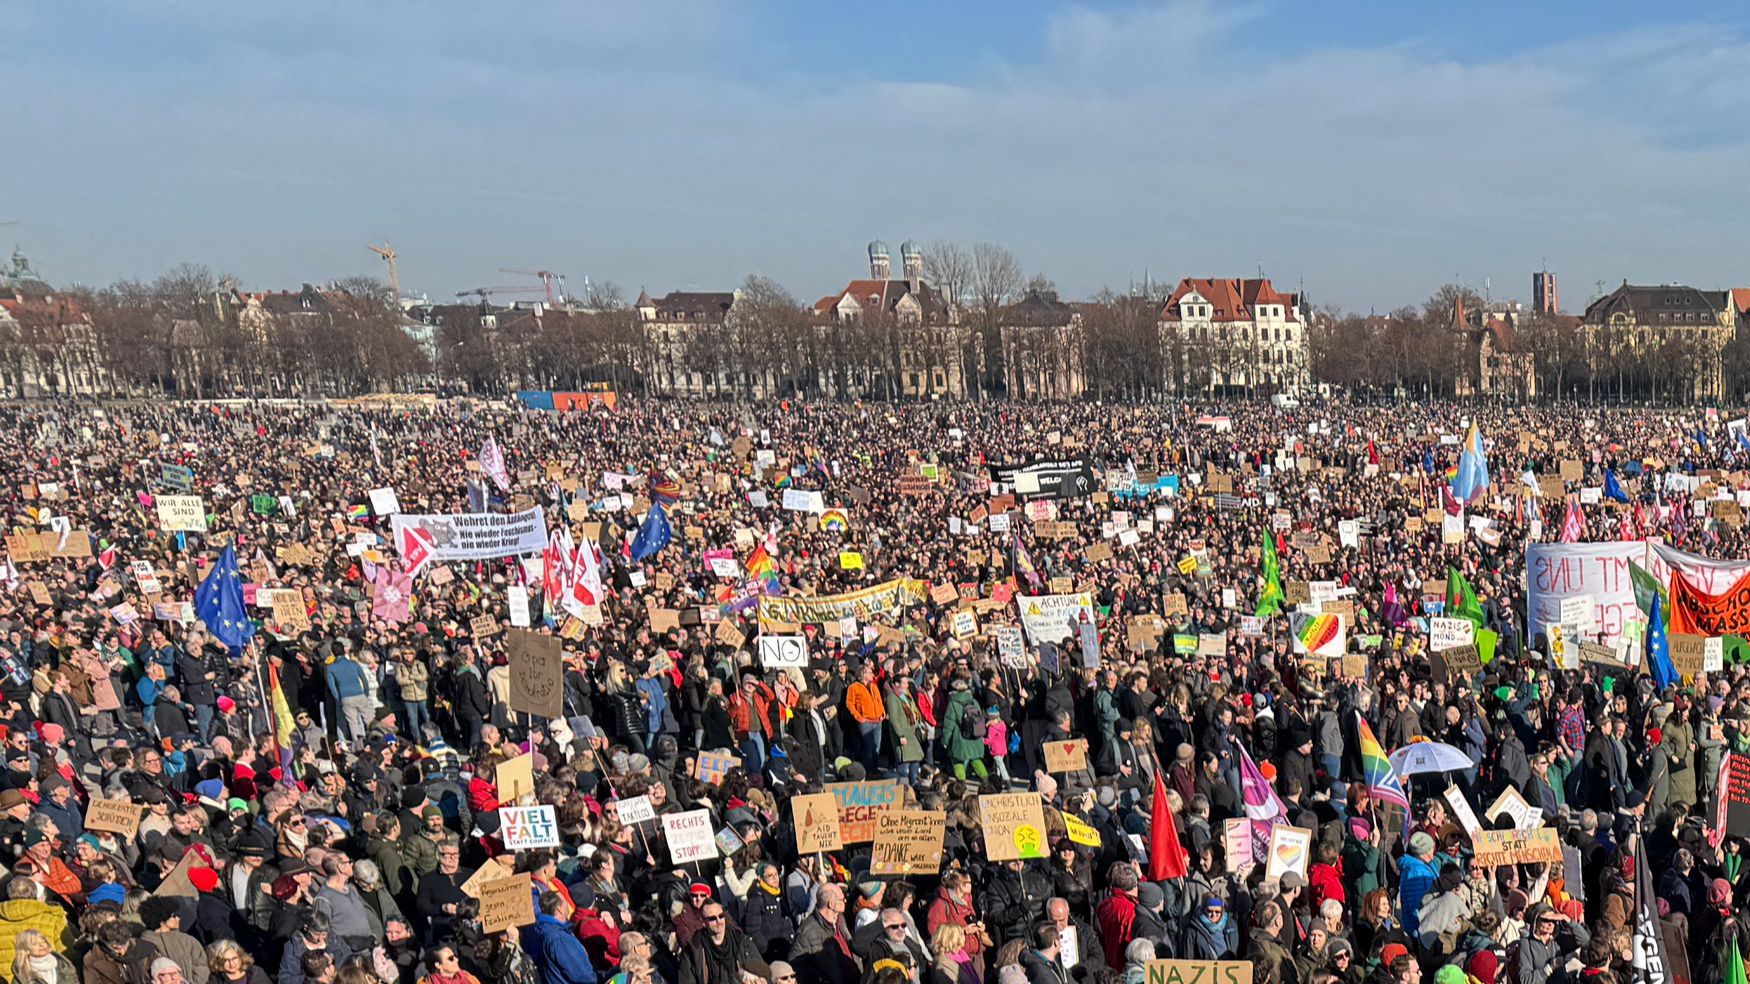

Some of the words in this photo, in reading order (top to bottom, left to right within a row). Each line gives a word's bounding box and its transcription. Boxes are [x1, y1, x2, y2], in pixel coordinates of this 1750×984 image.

[504, 808, 552, 823] VIEL
[670, 816, 705, 830] RECHTS
[507, 823, 552, 840] FALT
